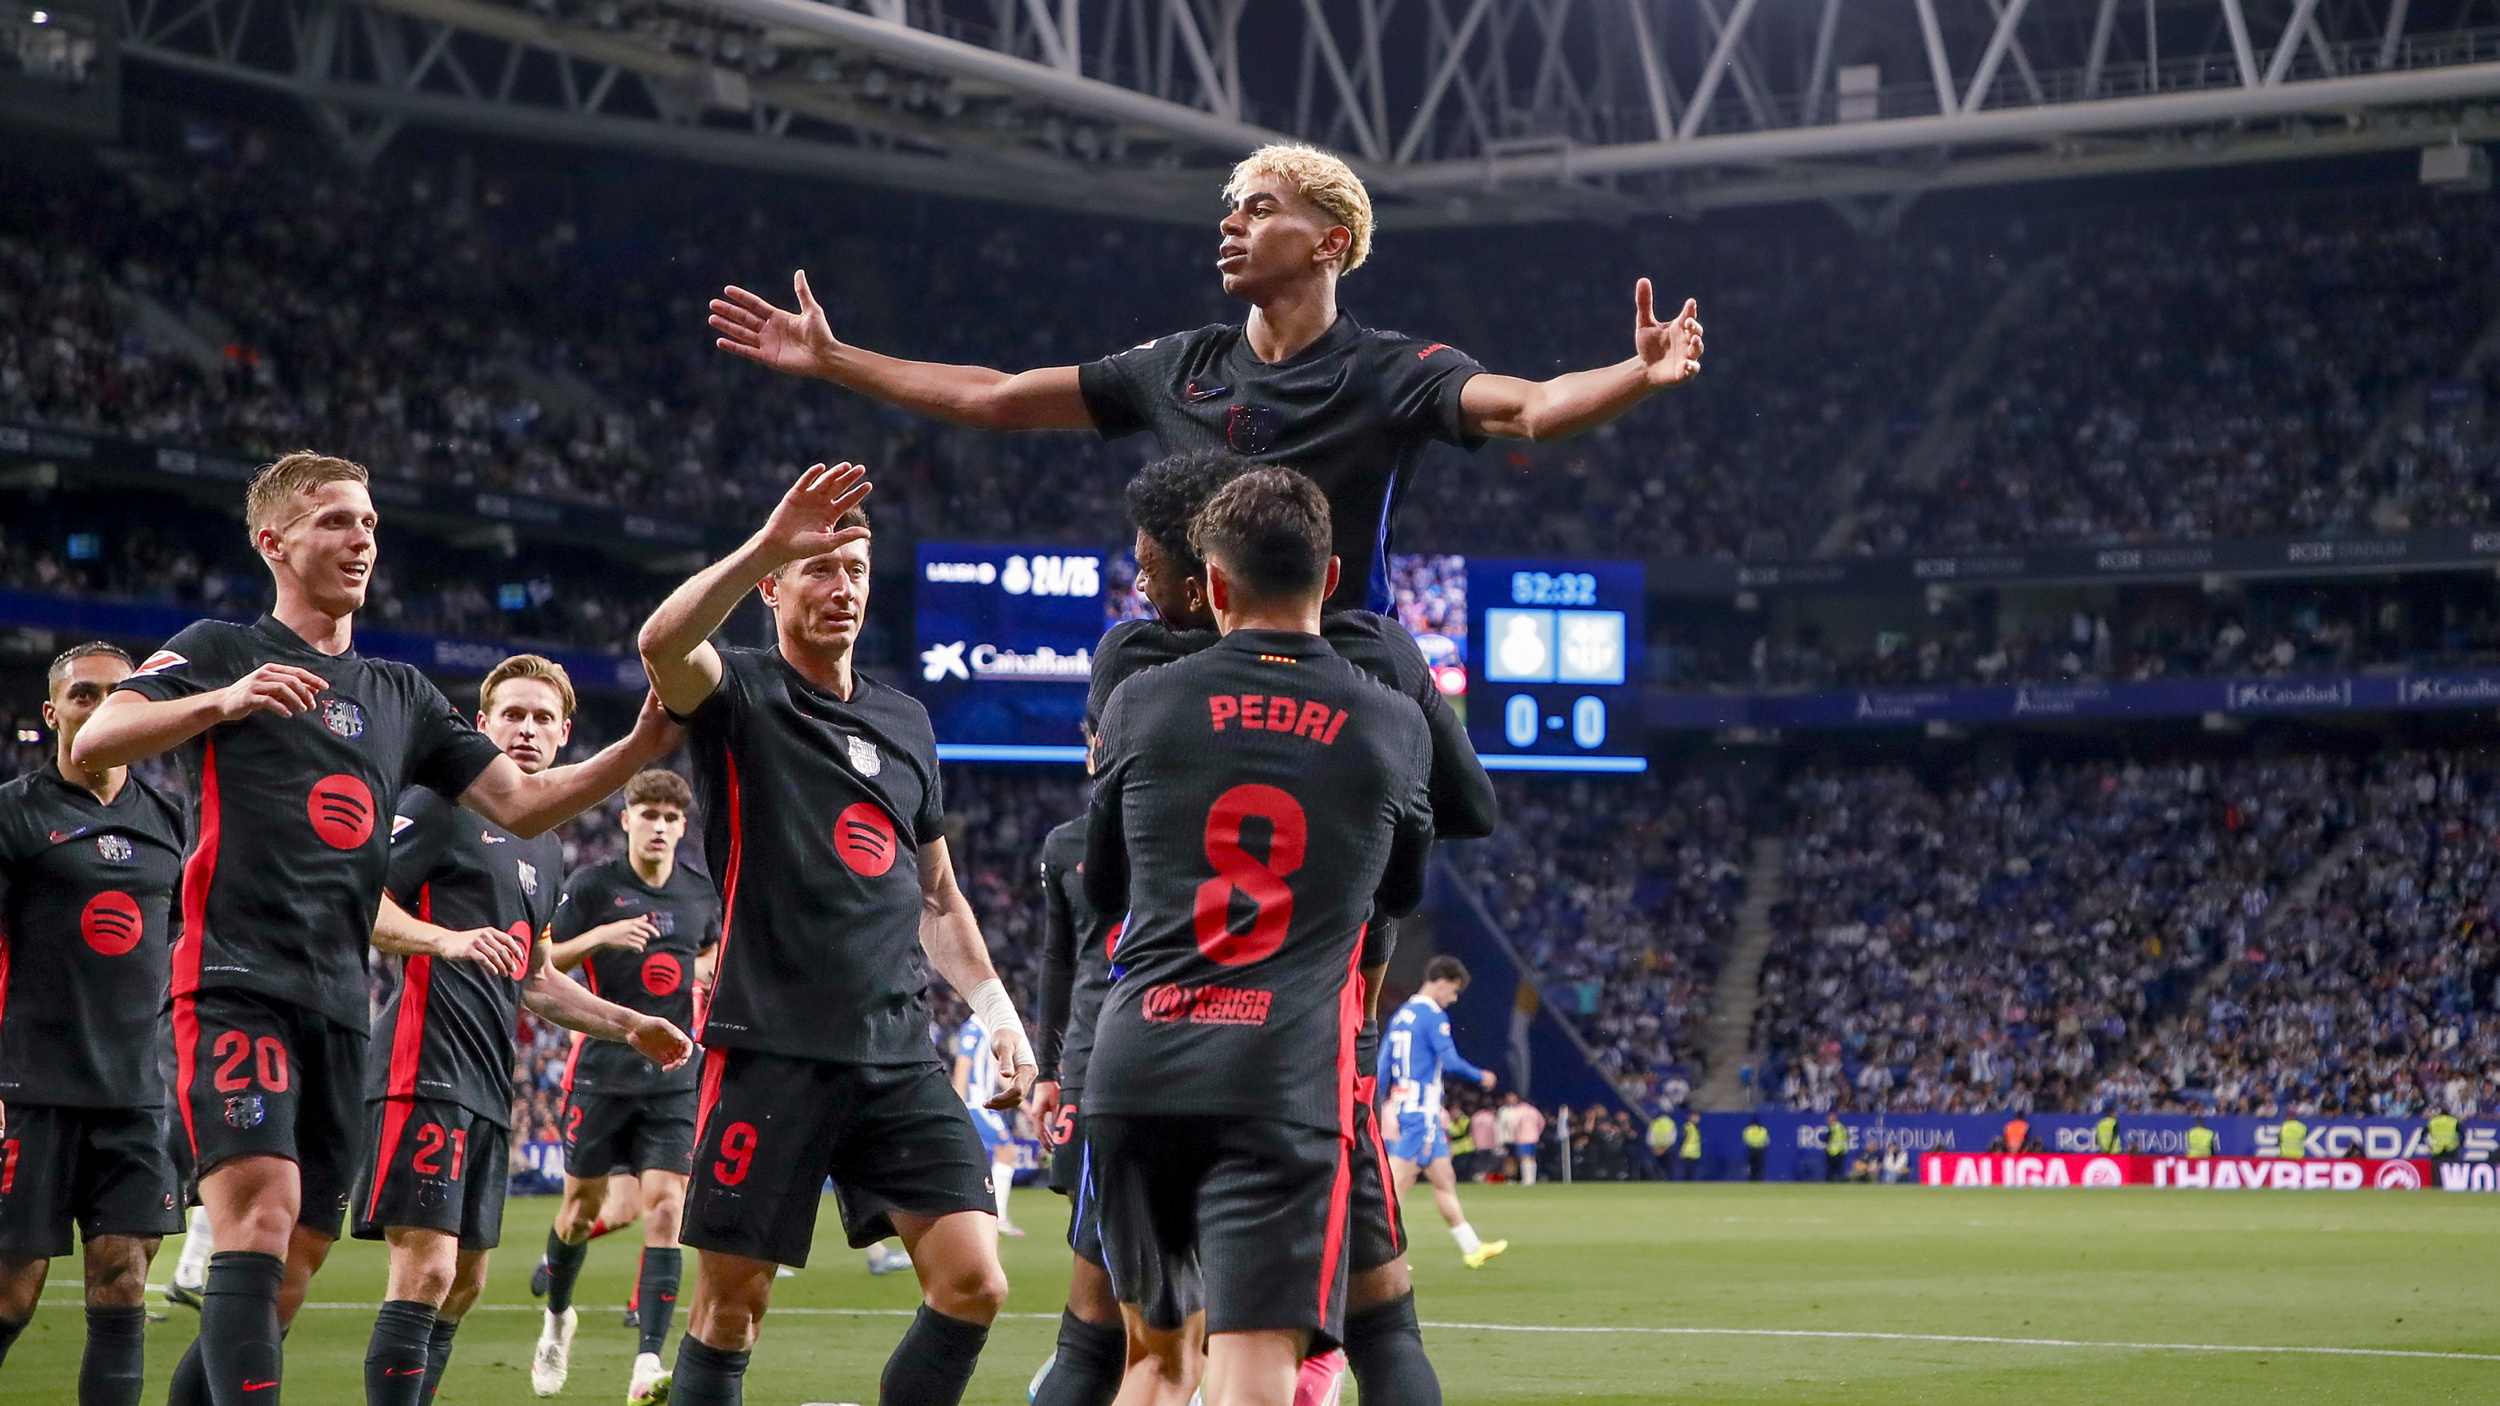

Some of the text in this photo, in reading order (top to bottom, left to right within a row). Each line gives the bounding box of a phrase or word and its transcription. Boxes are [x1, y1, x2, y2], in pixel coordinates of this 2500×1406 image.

[2471, 532, 2500, 551] RC
[1032, 555, 1099, 597] 24/25
[1511, 571, 1597, 606] 52:32
[970, 644, 1092, 675] CaixaBank
[2261, 683, 2341, 704] CaixaBank
[1208, 694, 1349, 746] PEDRI
[1505, 693, 1538, 748] 0
[1572, 695, 1606, 749] 0
[1193, 783, 1308, 967] 8
[1190, 1001, 1269, 1020] ACNUR
[1195, 984, 1274, 1008] UNHCR
[213, 1030, 289, 1094] 20
[1053, 1104, 1078, 1145] 5
[1797, 1125, 1956, 1150] RCE STADIUM
[2055, 1127, 2221, 1153] RC STADI
[413, 1122, 466, 1181] 21
[713, 1121, 759, 1186] 9
